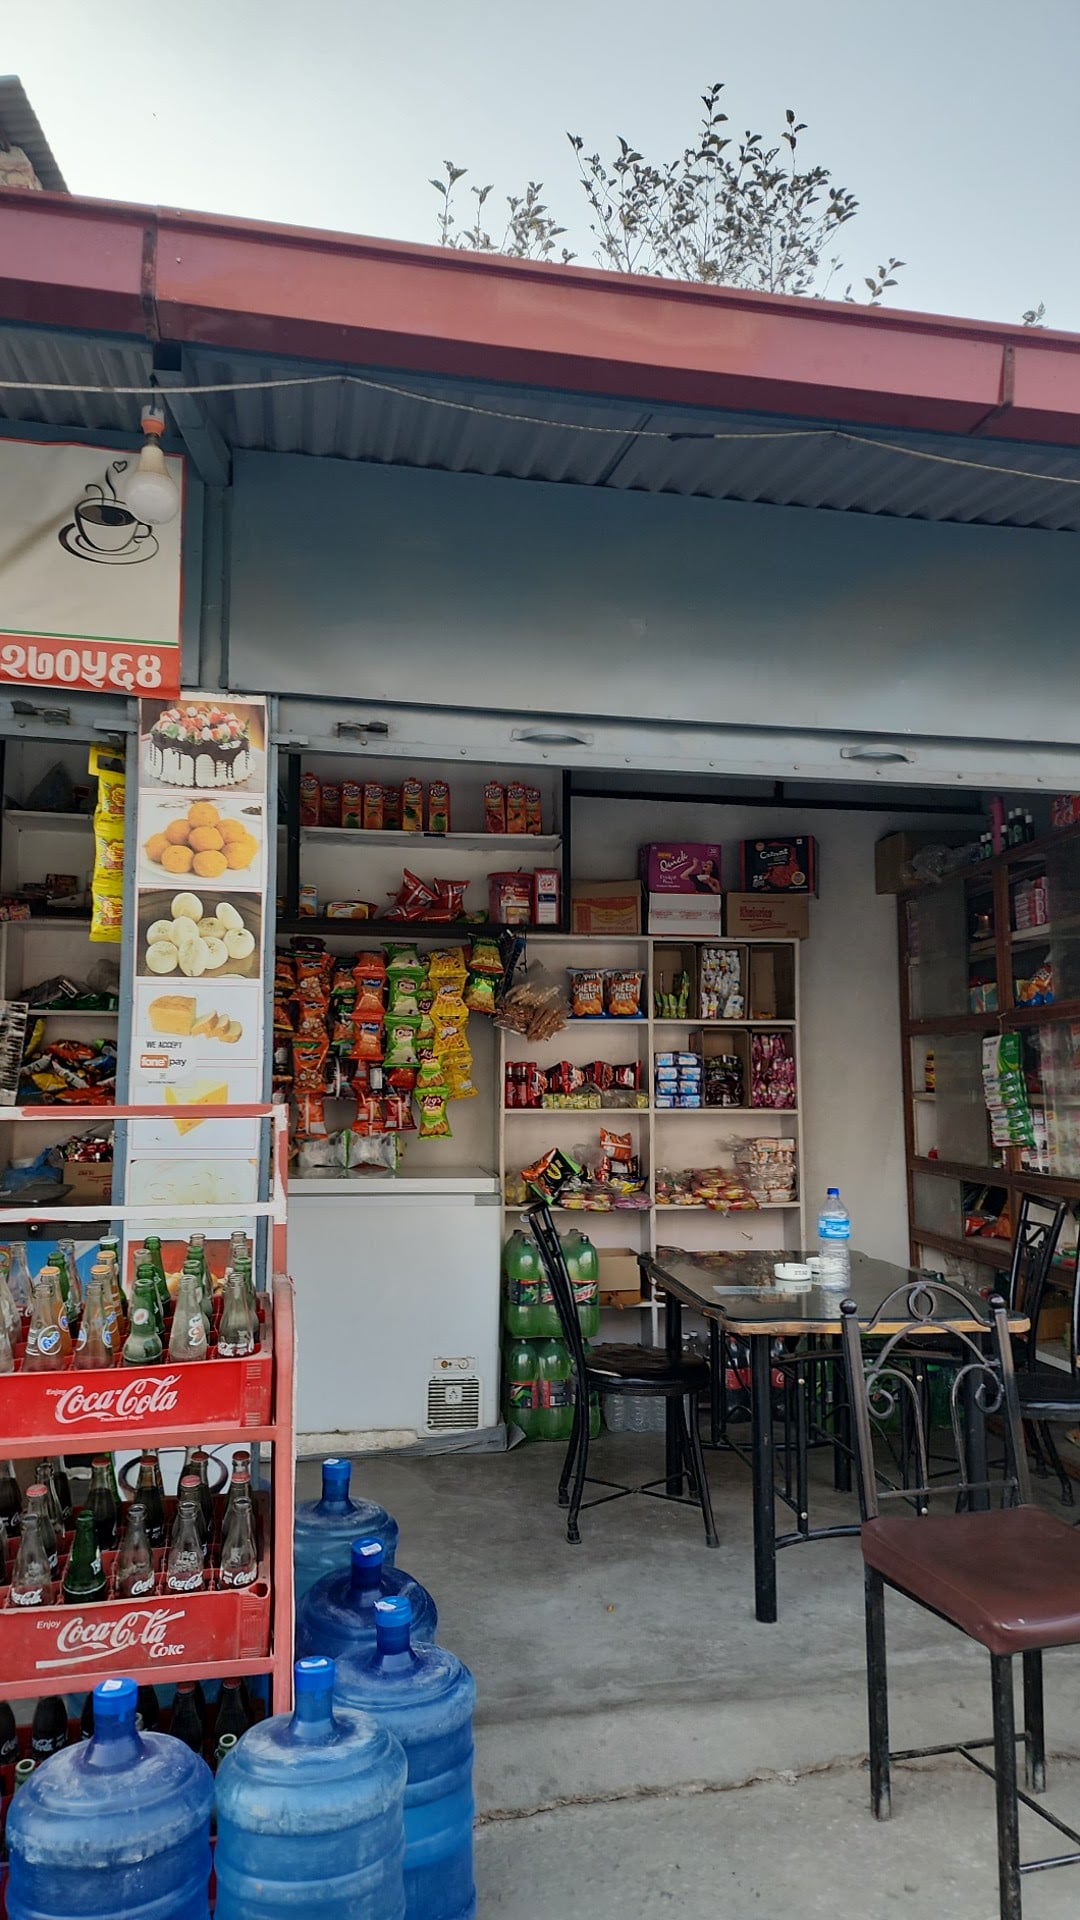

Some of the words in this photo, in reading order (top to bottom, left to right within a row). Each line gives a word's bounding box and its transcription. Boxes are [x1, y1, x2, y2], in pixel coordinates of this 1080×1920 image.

[660, 850, 688, 872] Quick
[146, 1040, 157, 1049] WE
[158, 1040, 183, 1049] ACCEPT
[55, 1375, 182, 1424] Coca-Cola
[36, 1620, 61, 1630] Enjoy
[57, 1609, 171, 1652] Coca-Cola
[149, 1642, 185, 1658] Coke
